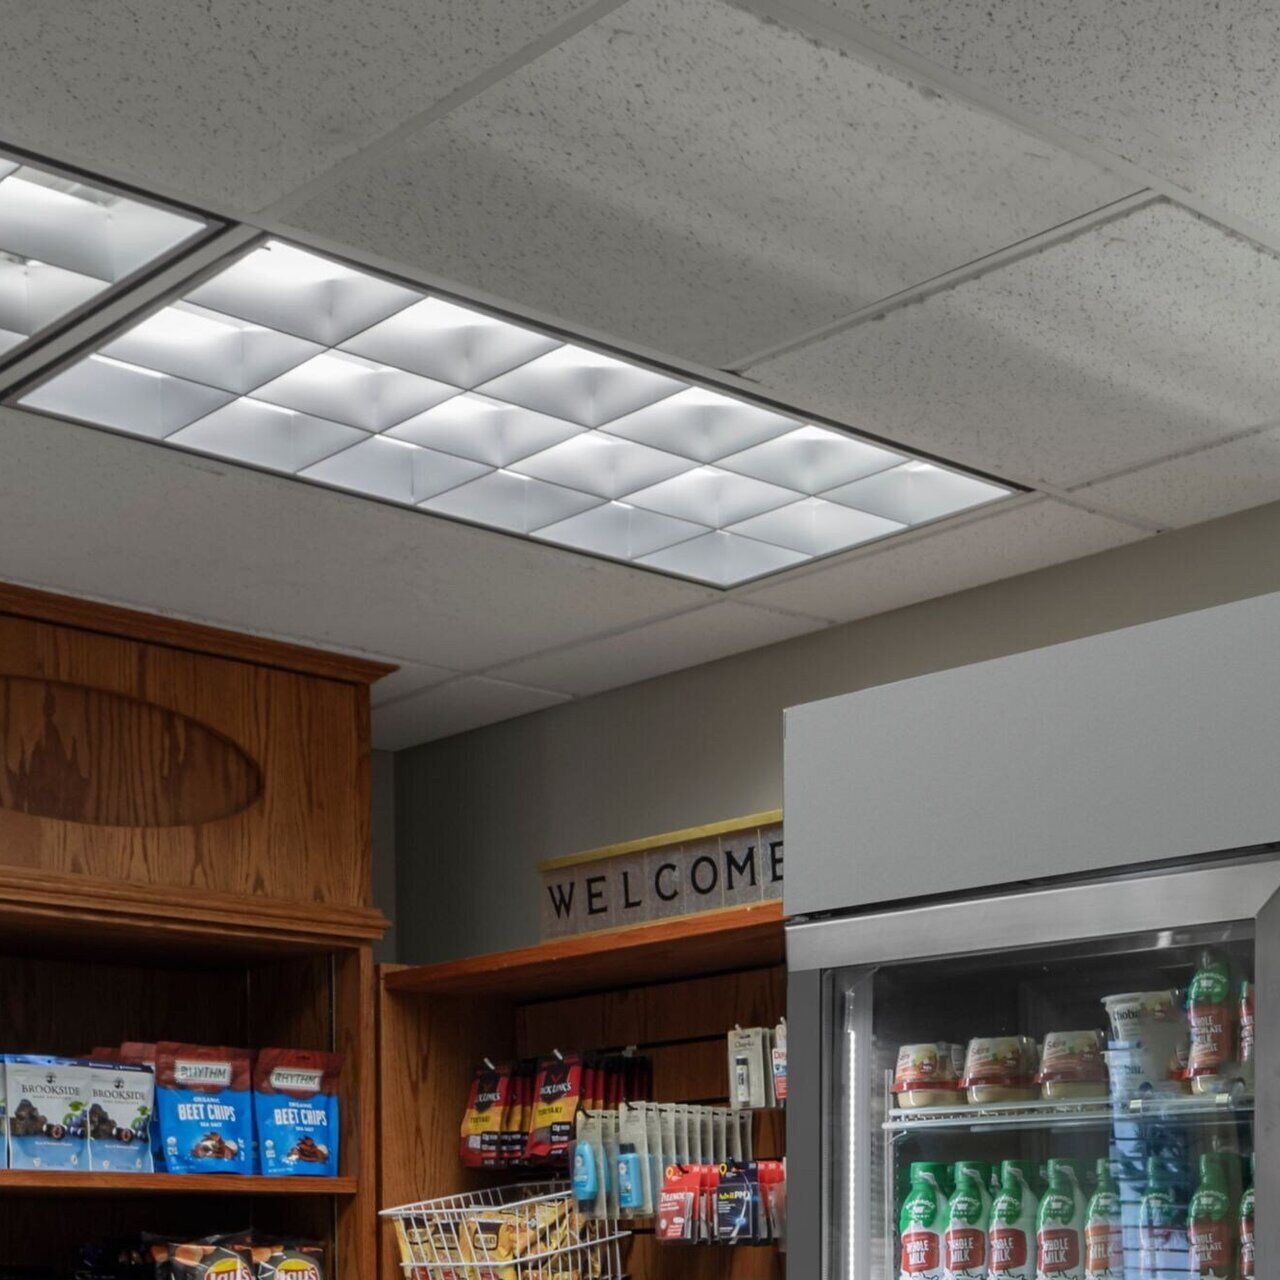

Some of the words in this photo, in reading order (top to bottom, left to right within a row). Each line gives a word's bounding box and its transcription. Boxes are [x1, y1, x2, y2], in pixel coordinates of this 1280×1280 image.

[547, 840, 783, 919] WELCOME
[22, 1084, 80, 1096] BROOKSIDE
[93, 1089, 145, 1100] BROOKSIDE
[178, 1104, 204, 1120] BEET
[207, 1106, 235, 1121] CHIPS
[274, 1108, 298, 1125] BEET
[300, 1110, 328, 1126] CHIPS
